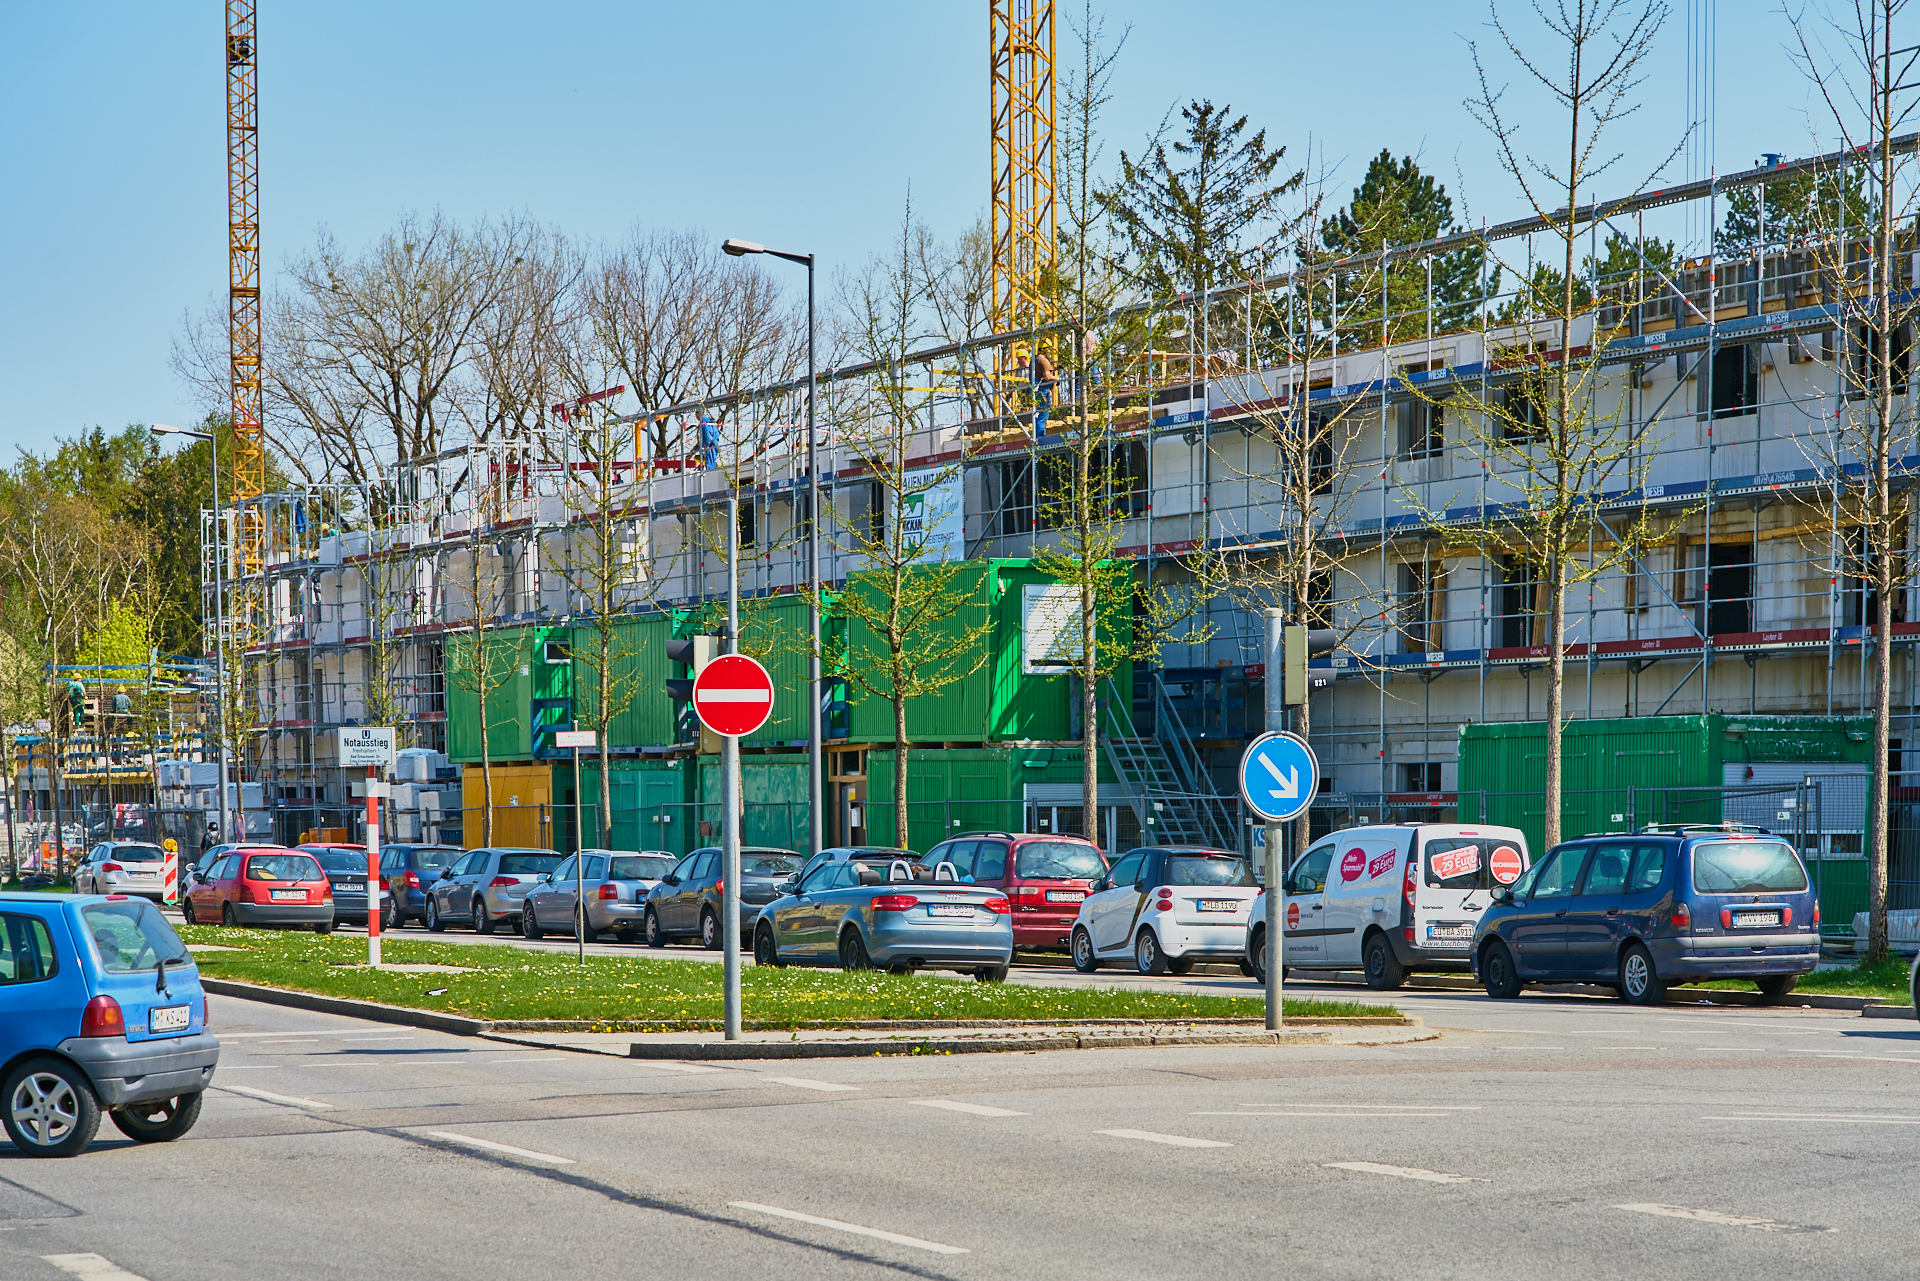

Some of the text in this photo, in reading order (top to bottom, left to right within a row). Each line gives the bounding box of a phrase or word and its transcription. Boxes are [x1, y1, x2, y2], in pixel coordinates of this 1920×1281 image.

[1766, 311, 1789, 325] WIESER
[1644, 332, 1667, 345] WIESER
[1428, 368, 1447, 381] WIESER
[1330, 386, 1349, 397] WIESER
[1173, 413, 1189, 424] WIESER
[1331, 658, 1348, 668] WIESER
[1425, 651, 1445, 663] WIESER
[343, 737, 389, 750] Notausstieg
[436, 767, 455, 776] UNIKA
[1371, 855, 1394, 875] 29 Euro
[1441, 854, 1477, 873] 29 Euro
[1433, 927, 1473, 937] EU BA 3911
[165, 1010, 176, 1026] KS
